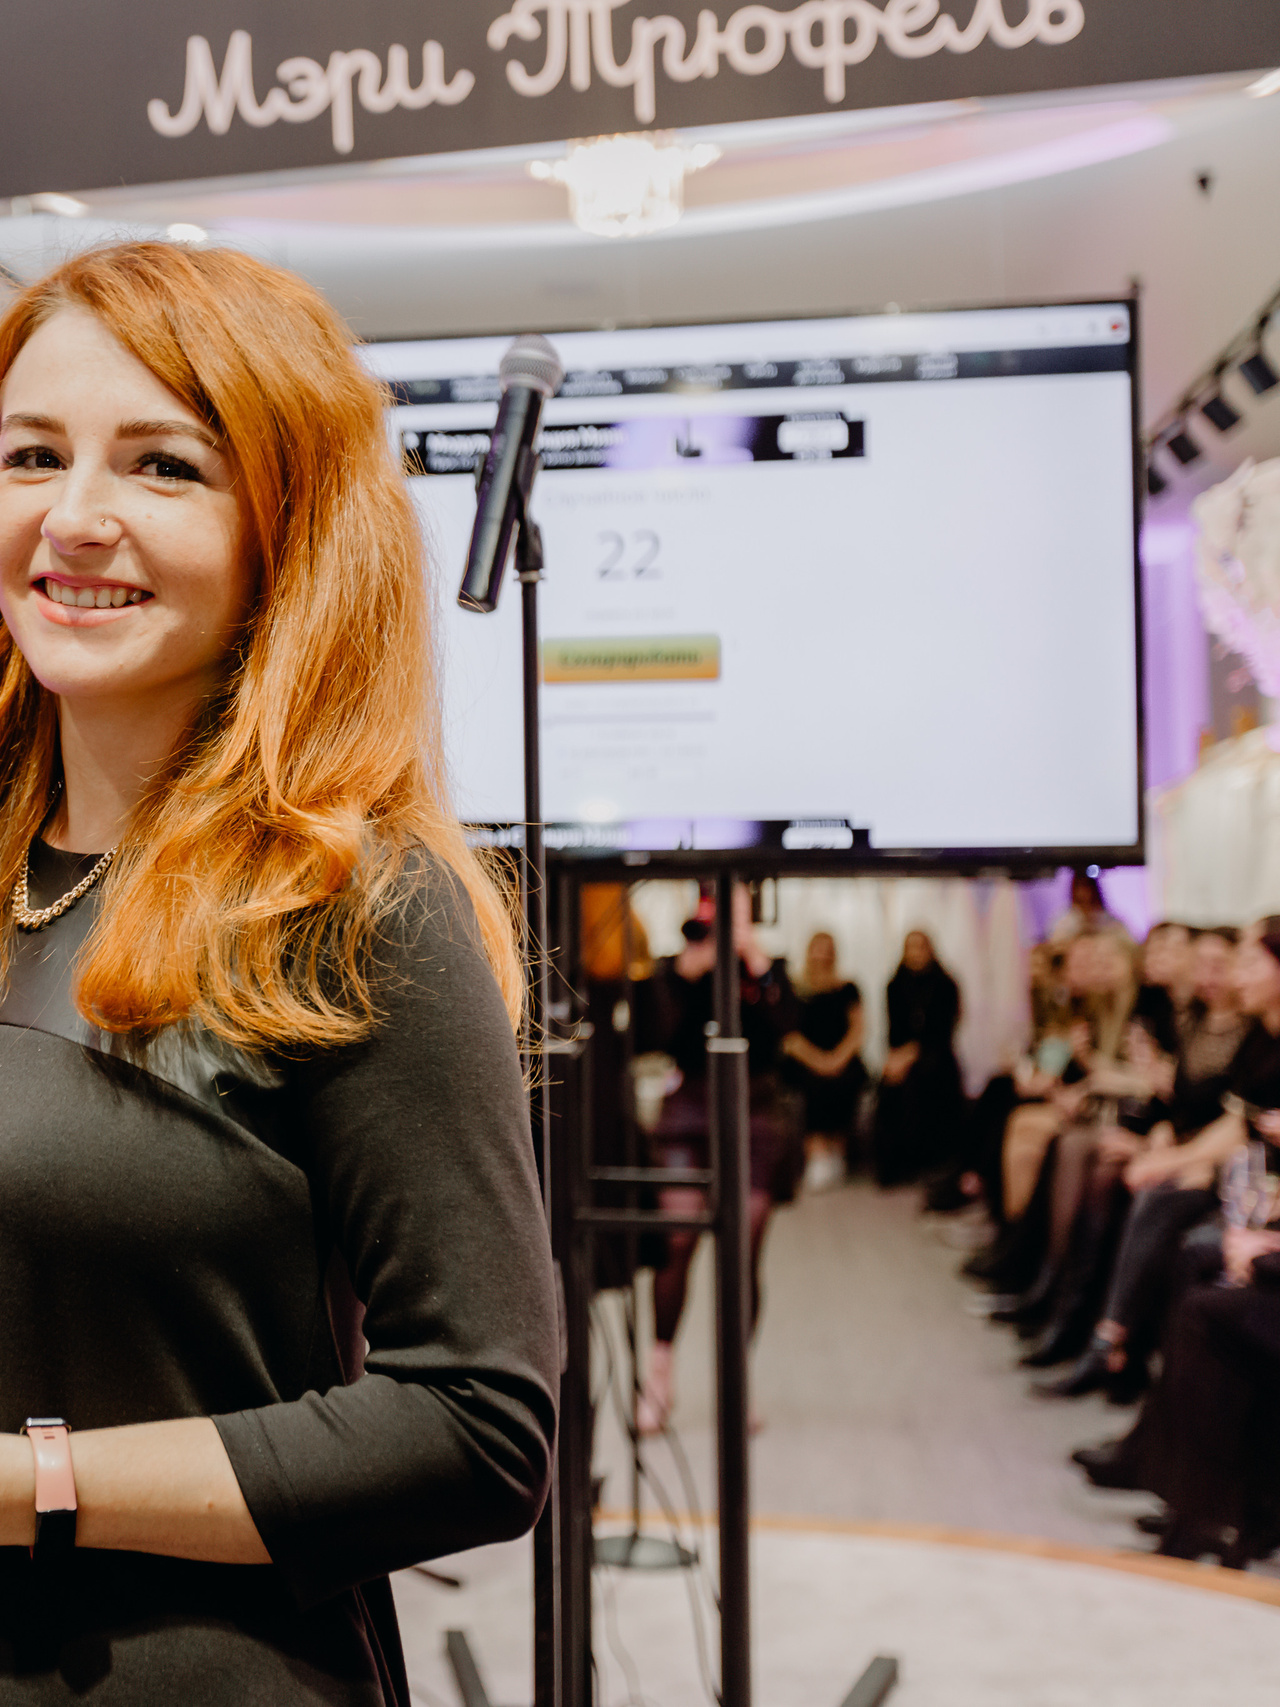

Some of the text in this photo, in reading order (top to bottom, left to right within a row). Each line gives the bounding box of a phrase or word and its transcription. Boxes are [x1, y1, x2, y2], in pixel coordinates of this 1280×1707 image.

[147, 0, 1085, 153] Мэри Трюфель
[596, 528, 663, 580] 22
